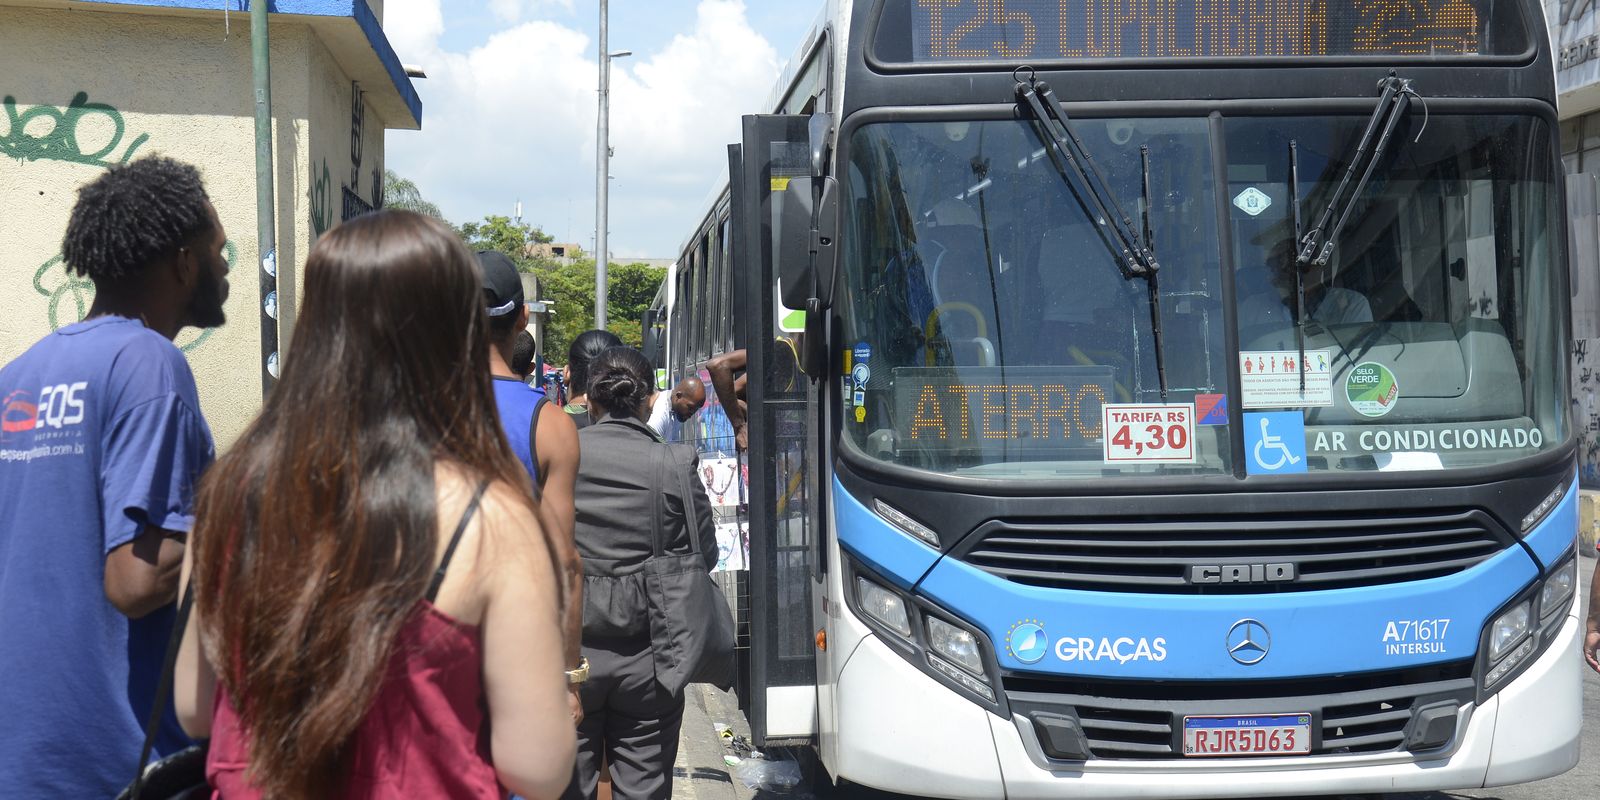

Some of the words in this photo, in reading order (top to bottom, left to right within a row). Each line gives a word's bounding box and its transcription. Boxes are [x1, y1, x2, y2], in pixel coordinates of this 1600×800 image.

[1558, 35, 1599, 72] REDE
[1350, 375, 1380, 384] VERDE
[35, 381, 89, 429] EQS
[911, 384, 1106, 439] ATERRO
[1111, 412, 1163, 423] TARIFA
[1167, 412, 1185, 423] R$
[1111, 424, 1187, 455] 4,30
[1314, 431, 1347, 451] AR
[1359, 428, 1543, 450] CONDICIONADO
[1191, 563, 1294, 583] CAIO
[1382, 619, 1450, 641] A71617
[1055, 637, 1167, 665] GRAÇAS
[1386, 642, 1446, 655] INTERSUL
[1195, 728, 1296, 753] RJR5D63
